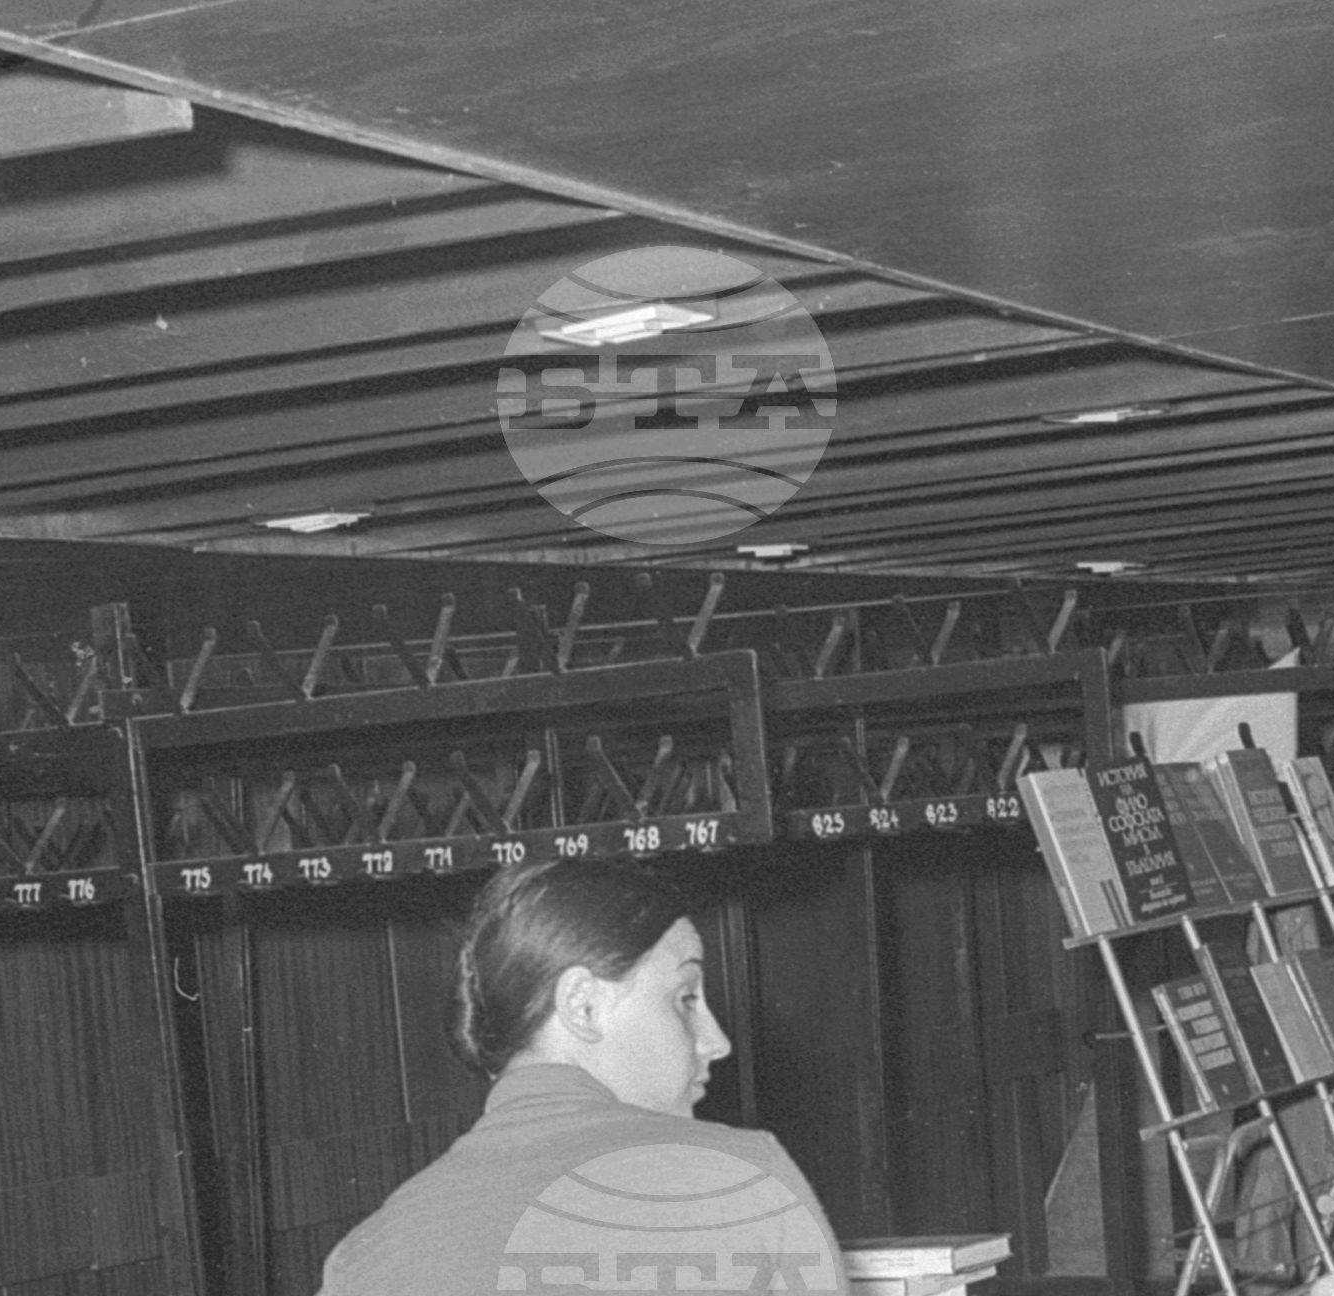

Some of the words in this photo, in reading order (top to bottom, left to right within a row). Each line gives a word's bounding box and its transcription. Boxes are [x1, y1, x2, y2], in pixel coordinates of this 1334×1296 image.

[925, 802, 959, 826] 823
[623, 825, 661, 852] 768
[685, 820, 720, 846] 767
[425, 846, 454, 869] 771
[492, 842, 526, 864] 770
[555, 834, 590, 858] 769
[181, 868, 212, 890] 775
[244, 863, 274, 886] 774
[299, 858, 333, 880] 773
[14, 883, 42, 904] 777
[68, 879, 96, 901] 776
